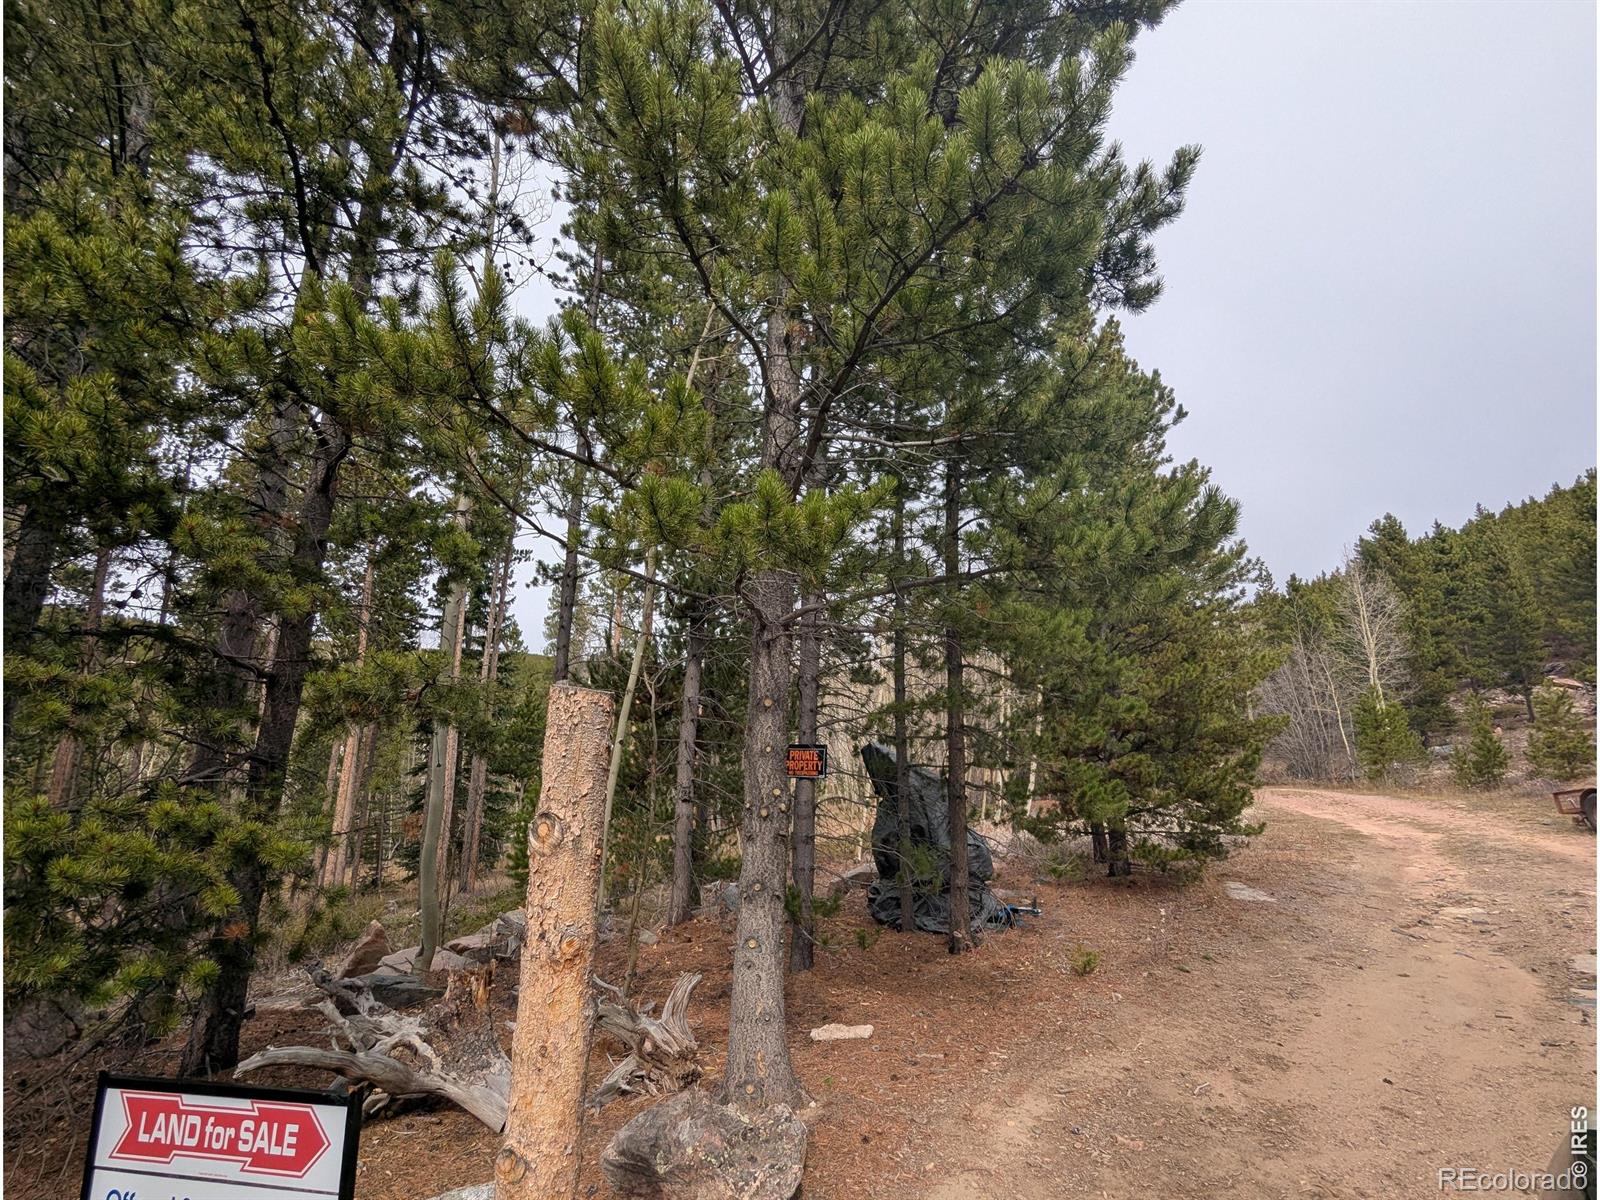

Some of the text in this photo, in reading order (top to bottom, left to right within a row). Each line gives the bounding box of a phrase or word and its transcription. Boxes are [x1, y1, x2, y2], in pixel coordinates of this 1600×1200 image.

[790, 750, 819, 760] PRIVATE
[785, 760, 823, 771] PROPERTY
[138, 1112, 300, 1157] LAND for SALE
